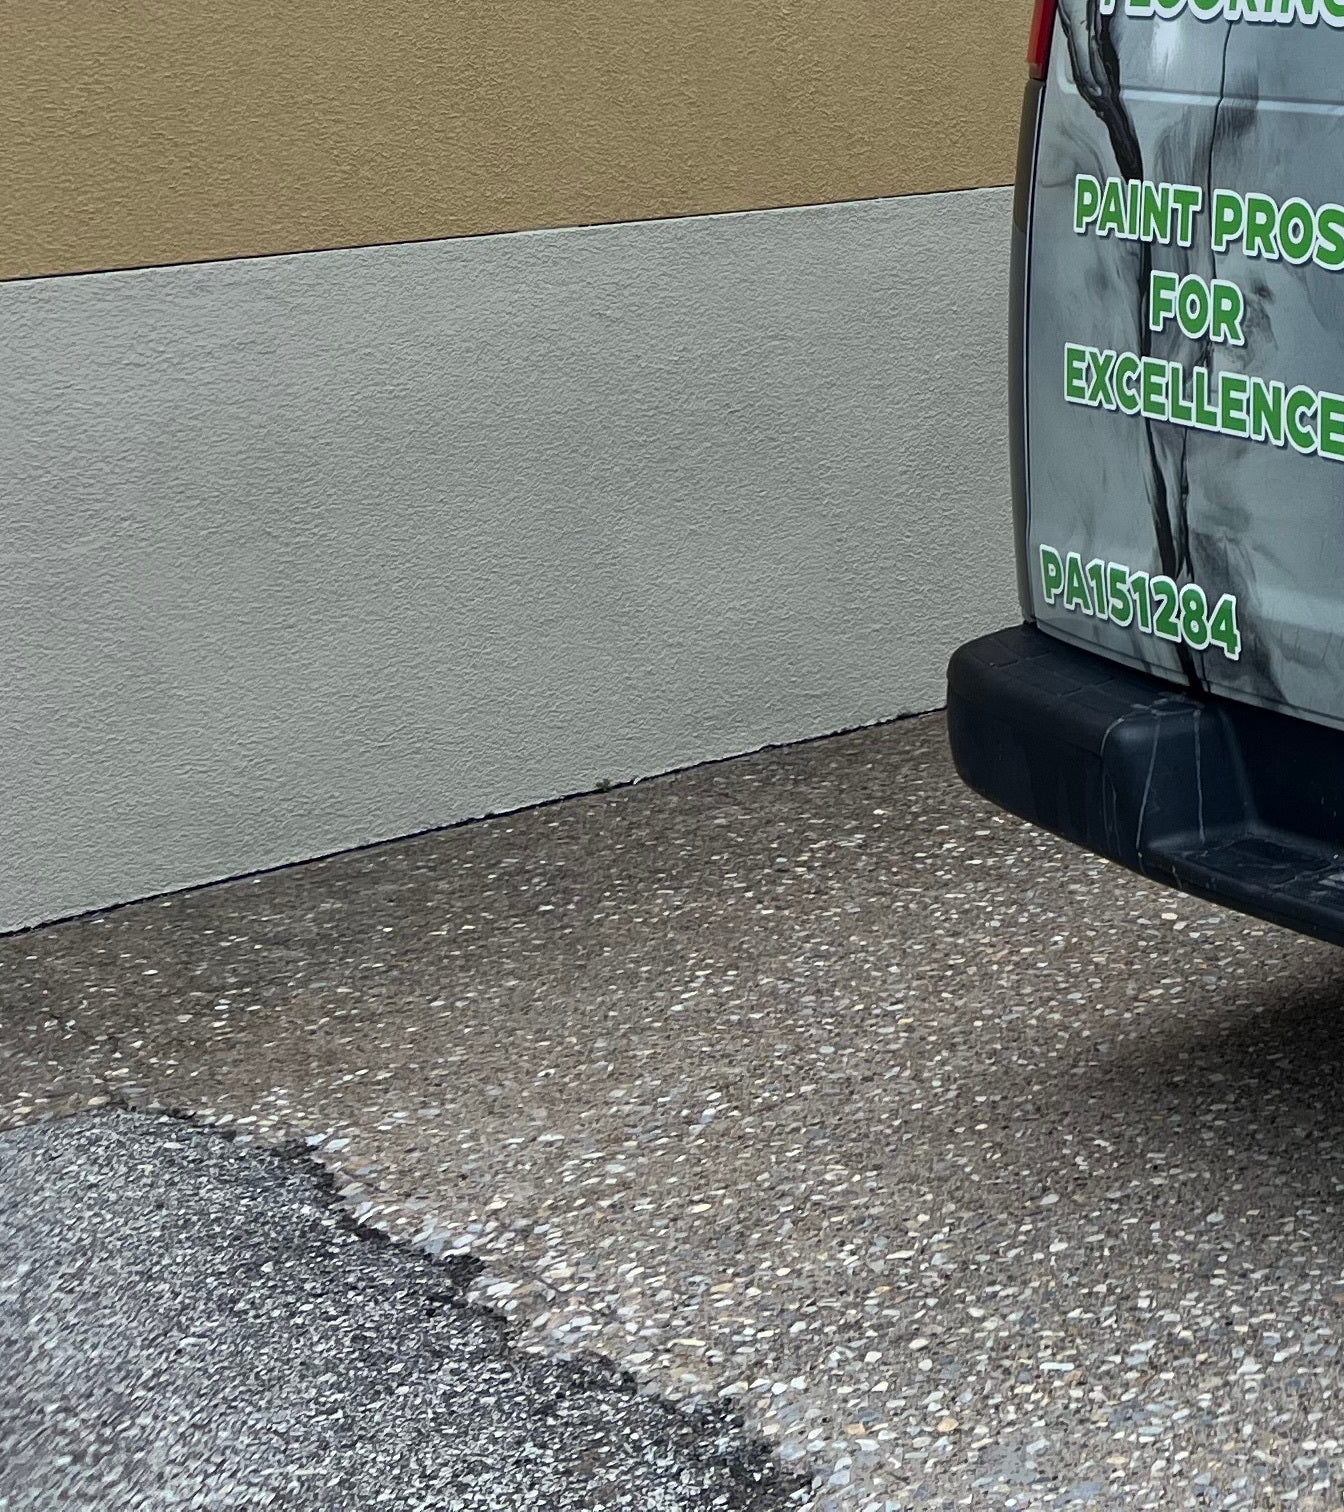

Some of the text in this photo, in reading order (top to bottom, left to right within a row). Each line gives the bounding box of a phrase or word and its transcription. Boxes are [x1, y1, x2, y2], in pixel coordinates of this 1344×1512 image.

[1073, 175, 1202, 247] PAINT
[1149, 269, 1245, 346] FOR
[1039, 544, 1242, 660] PA151284
